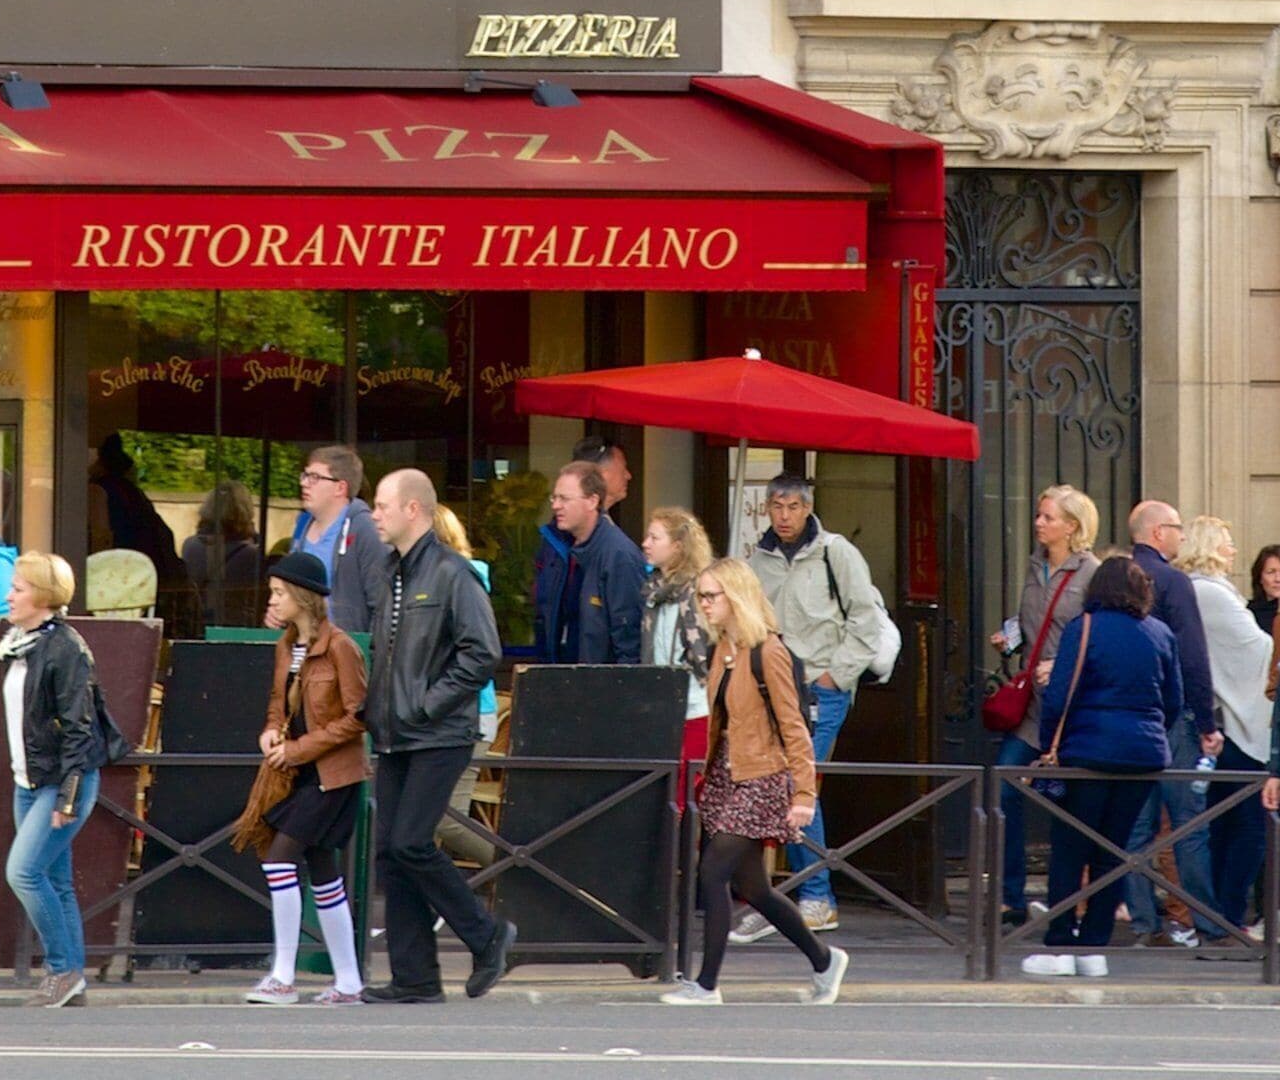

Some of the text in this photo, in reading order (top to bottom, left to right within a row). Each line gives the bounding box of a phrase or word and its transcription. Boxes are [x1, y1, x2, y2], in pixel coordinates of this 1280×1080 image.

[465, 13, 681, 59] PIZZERIA
[265, 124, 669, 164] PIZZA
[73, 224, 739, 270] RISTORANTE ITALIANO
[913, 282, 930, 408] GLACES
[100, 356, 151, 397] Salon
[242, 355, 330, 392] Breakfast
